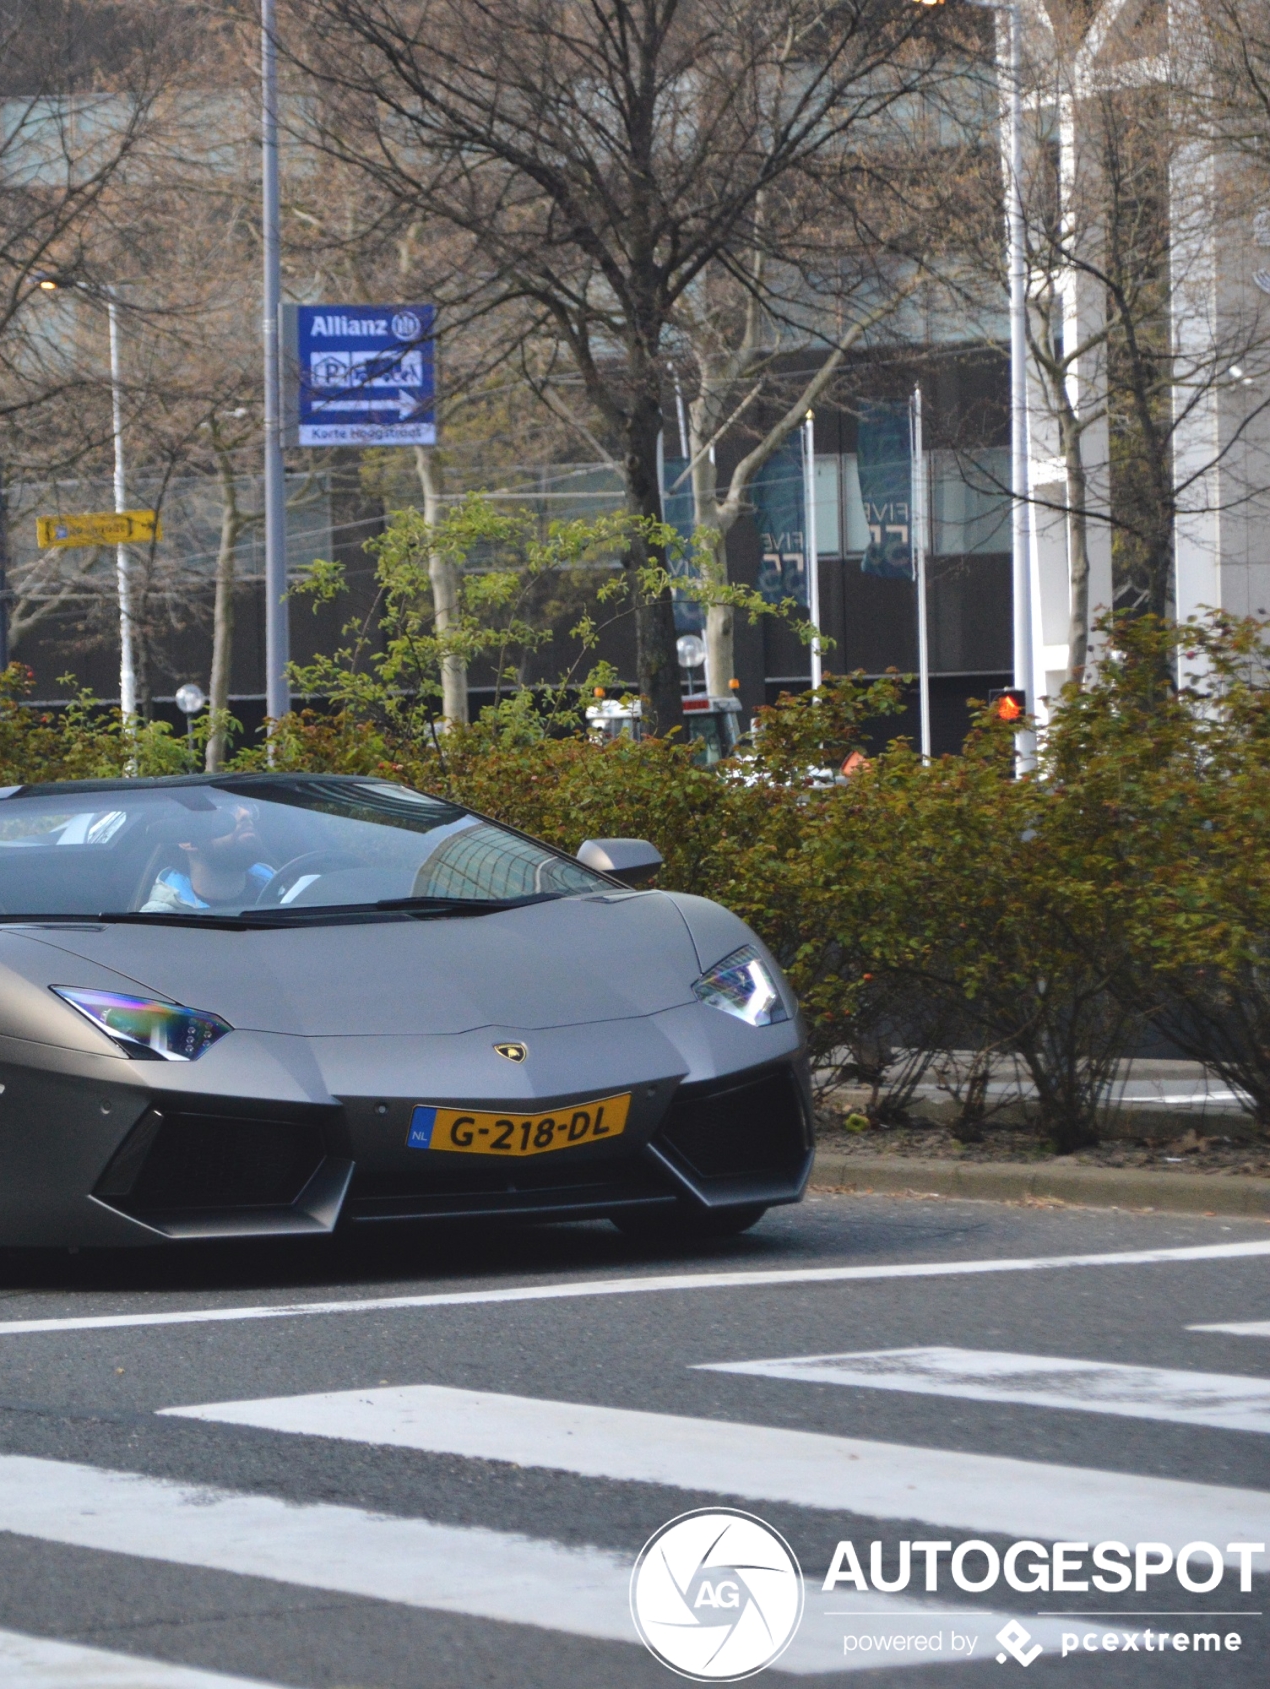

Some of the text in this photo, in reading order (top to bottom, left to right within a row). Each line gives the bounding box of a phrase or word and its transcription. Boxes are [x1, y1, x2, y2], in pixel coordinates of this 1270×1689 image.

[310, 316, 388, 337] Allianz
[312, 429, 346, 439] Korte
[412, 1106, 610, 1151] NL G-218-DL
